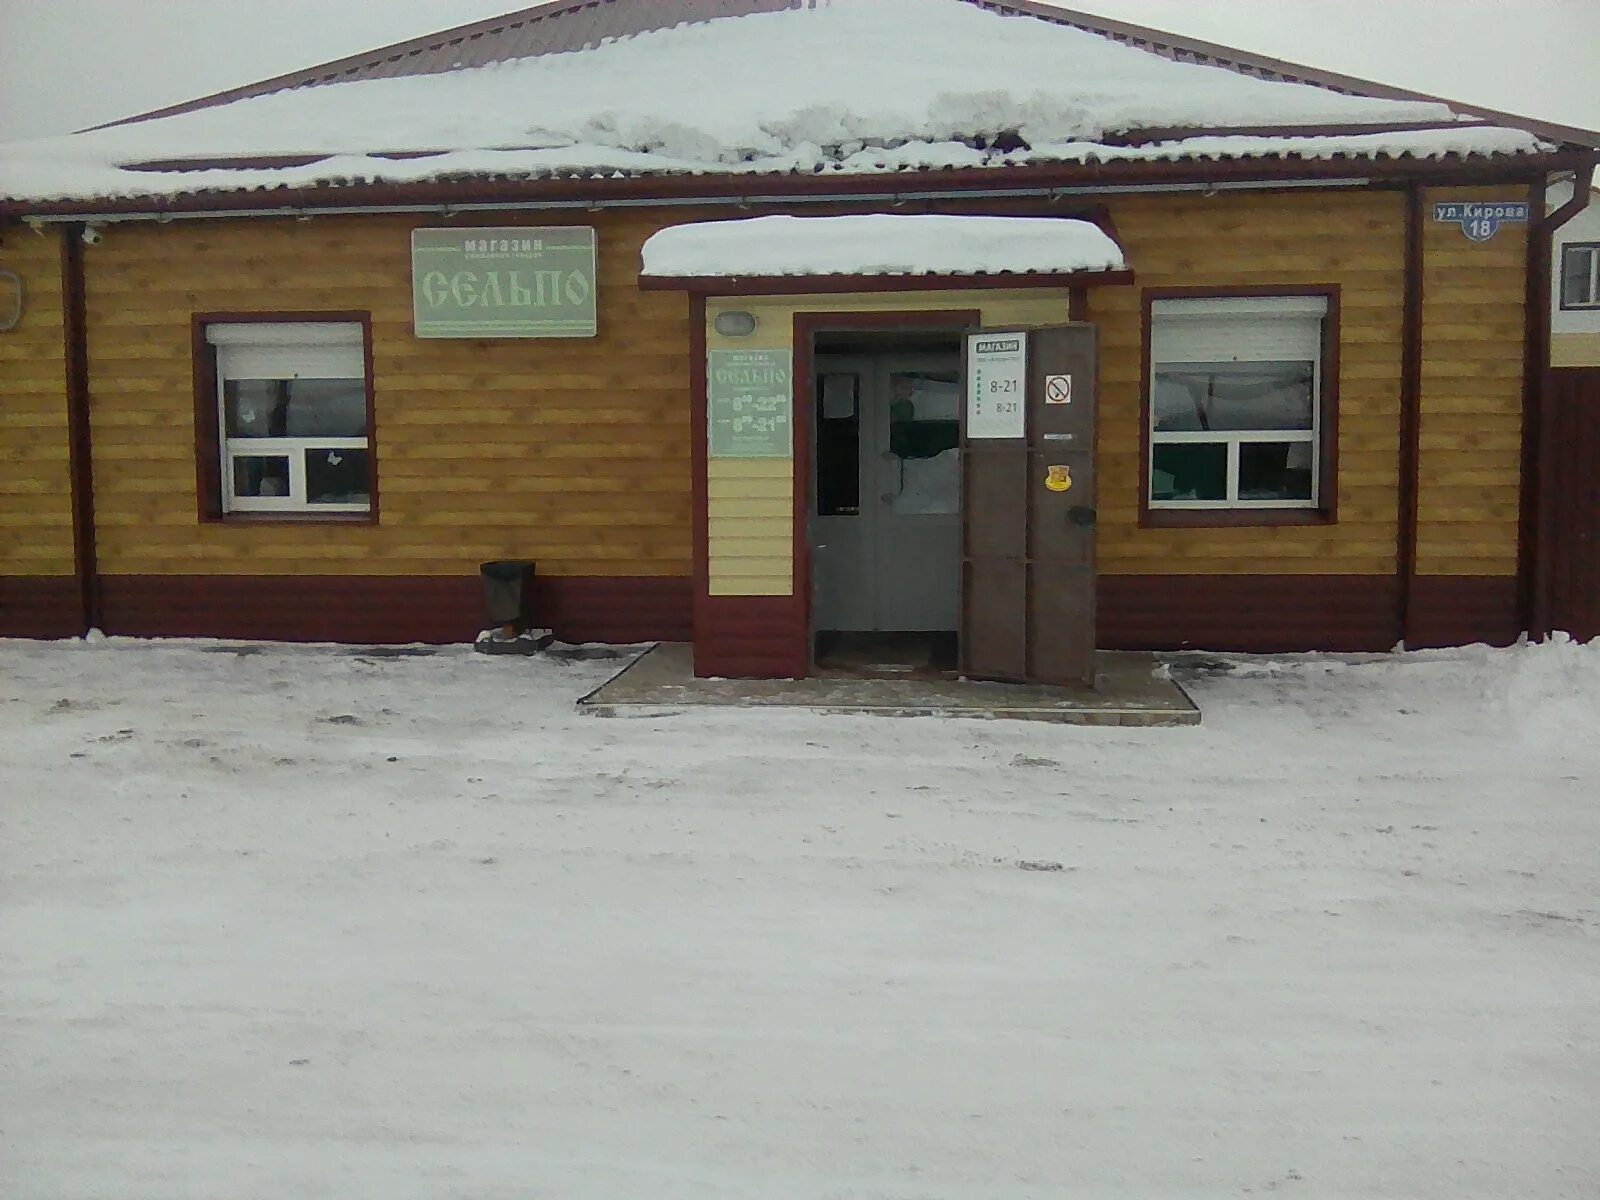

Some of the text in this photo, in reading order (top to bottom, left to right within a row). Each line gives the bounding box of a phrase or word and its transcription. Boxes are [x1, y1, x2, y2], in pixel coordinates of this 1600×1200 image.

[1470, 220, 1491, 237] 18
[422, 269, 589, 308] СЕЛЬПО
[990, 379, 1017, 393] 8-21
[996, 402, 1017, 413] 8-21
